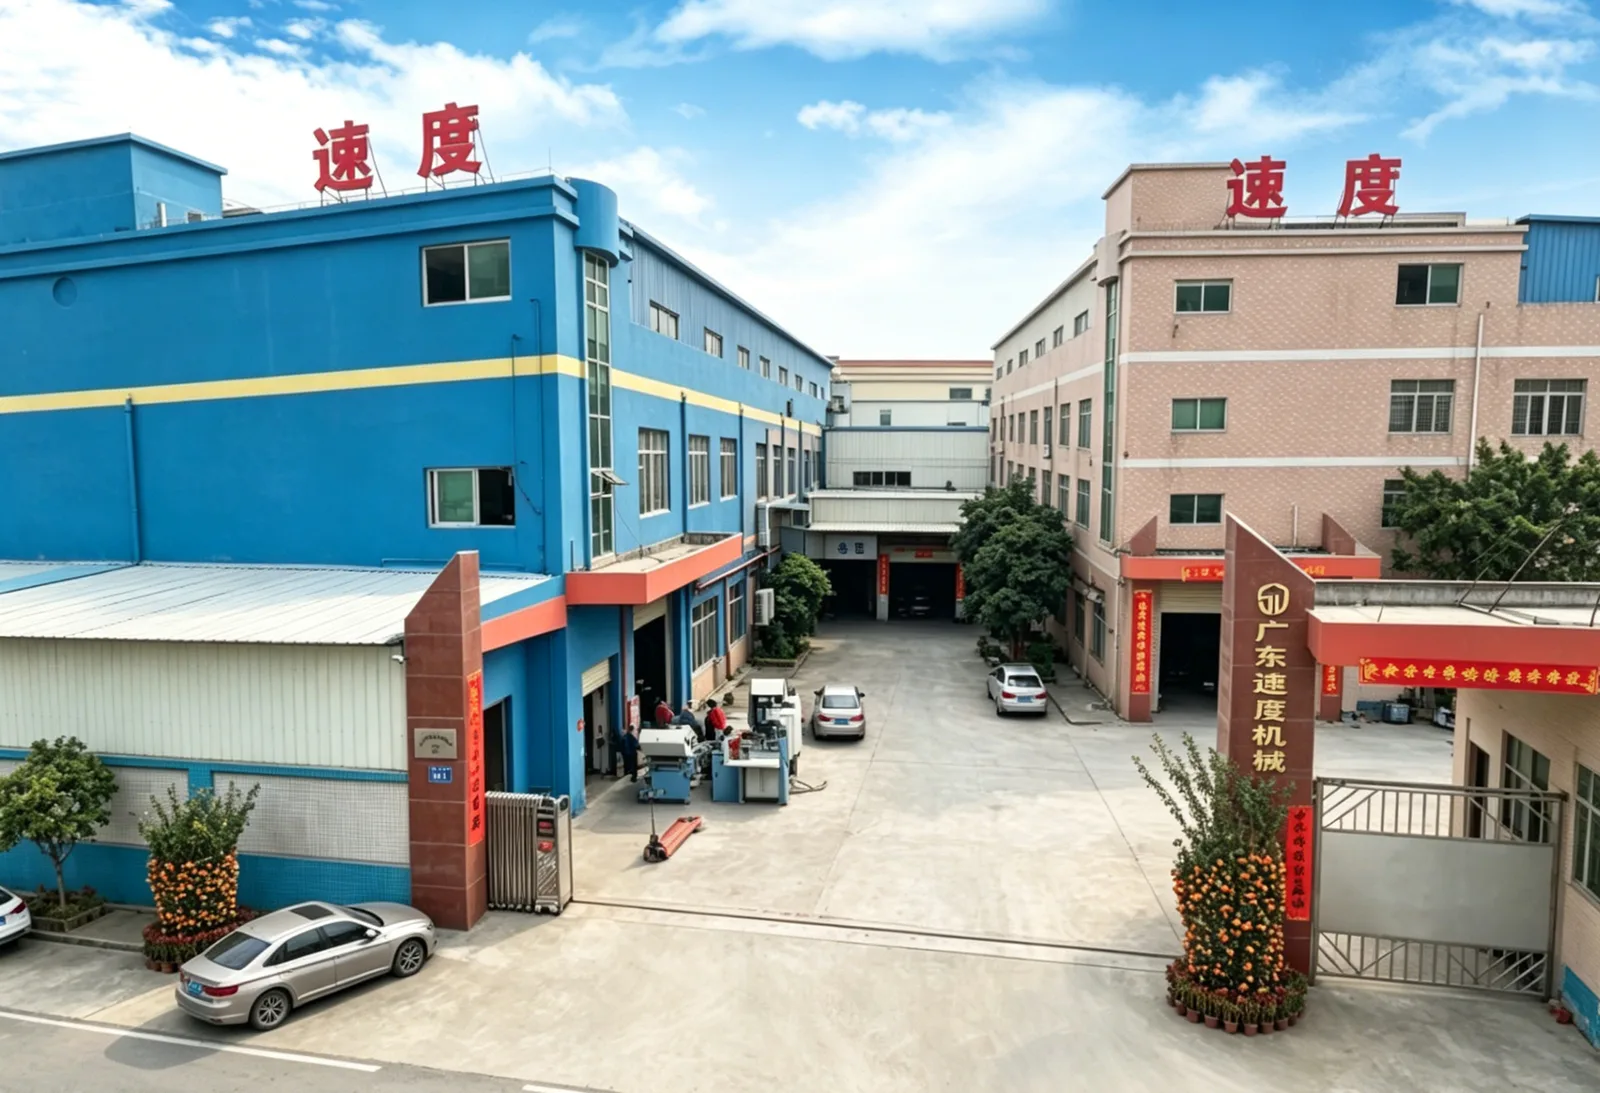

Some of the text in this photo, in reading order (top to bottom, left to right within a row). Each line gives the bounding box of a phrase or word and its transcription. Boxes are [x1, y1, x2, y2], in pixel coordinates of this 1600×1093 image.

[312, 102, 482, 192] 速度
[1227, 153, 1402, 218] 速度
[1252, 620, 1289, 773] 广东速度机械
